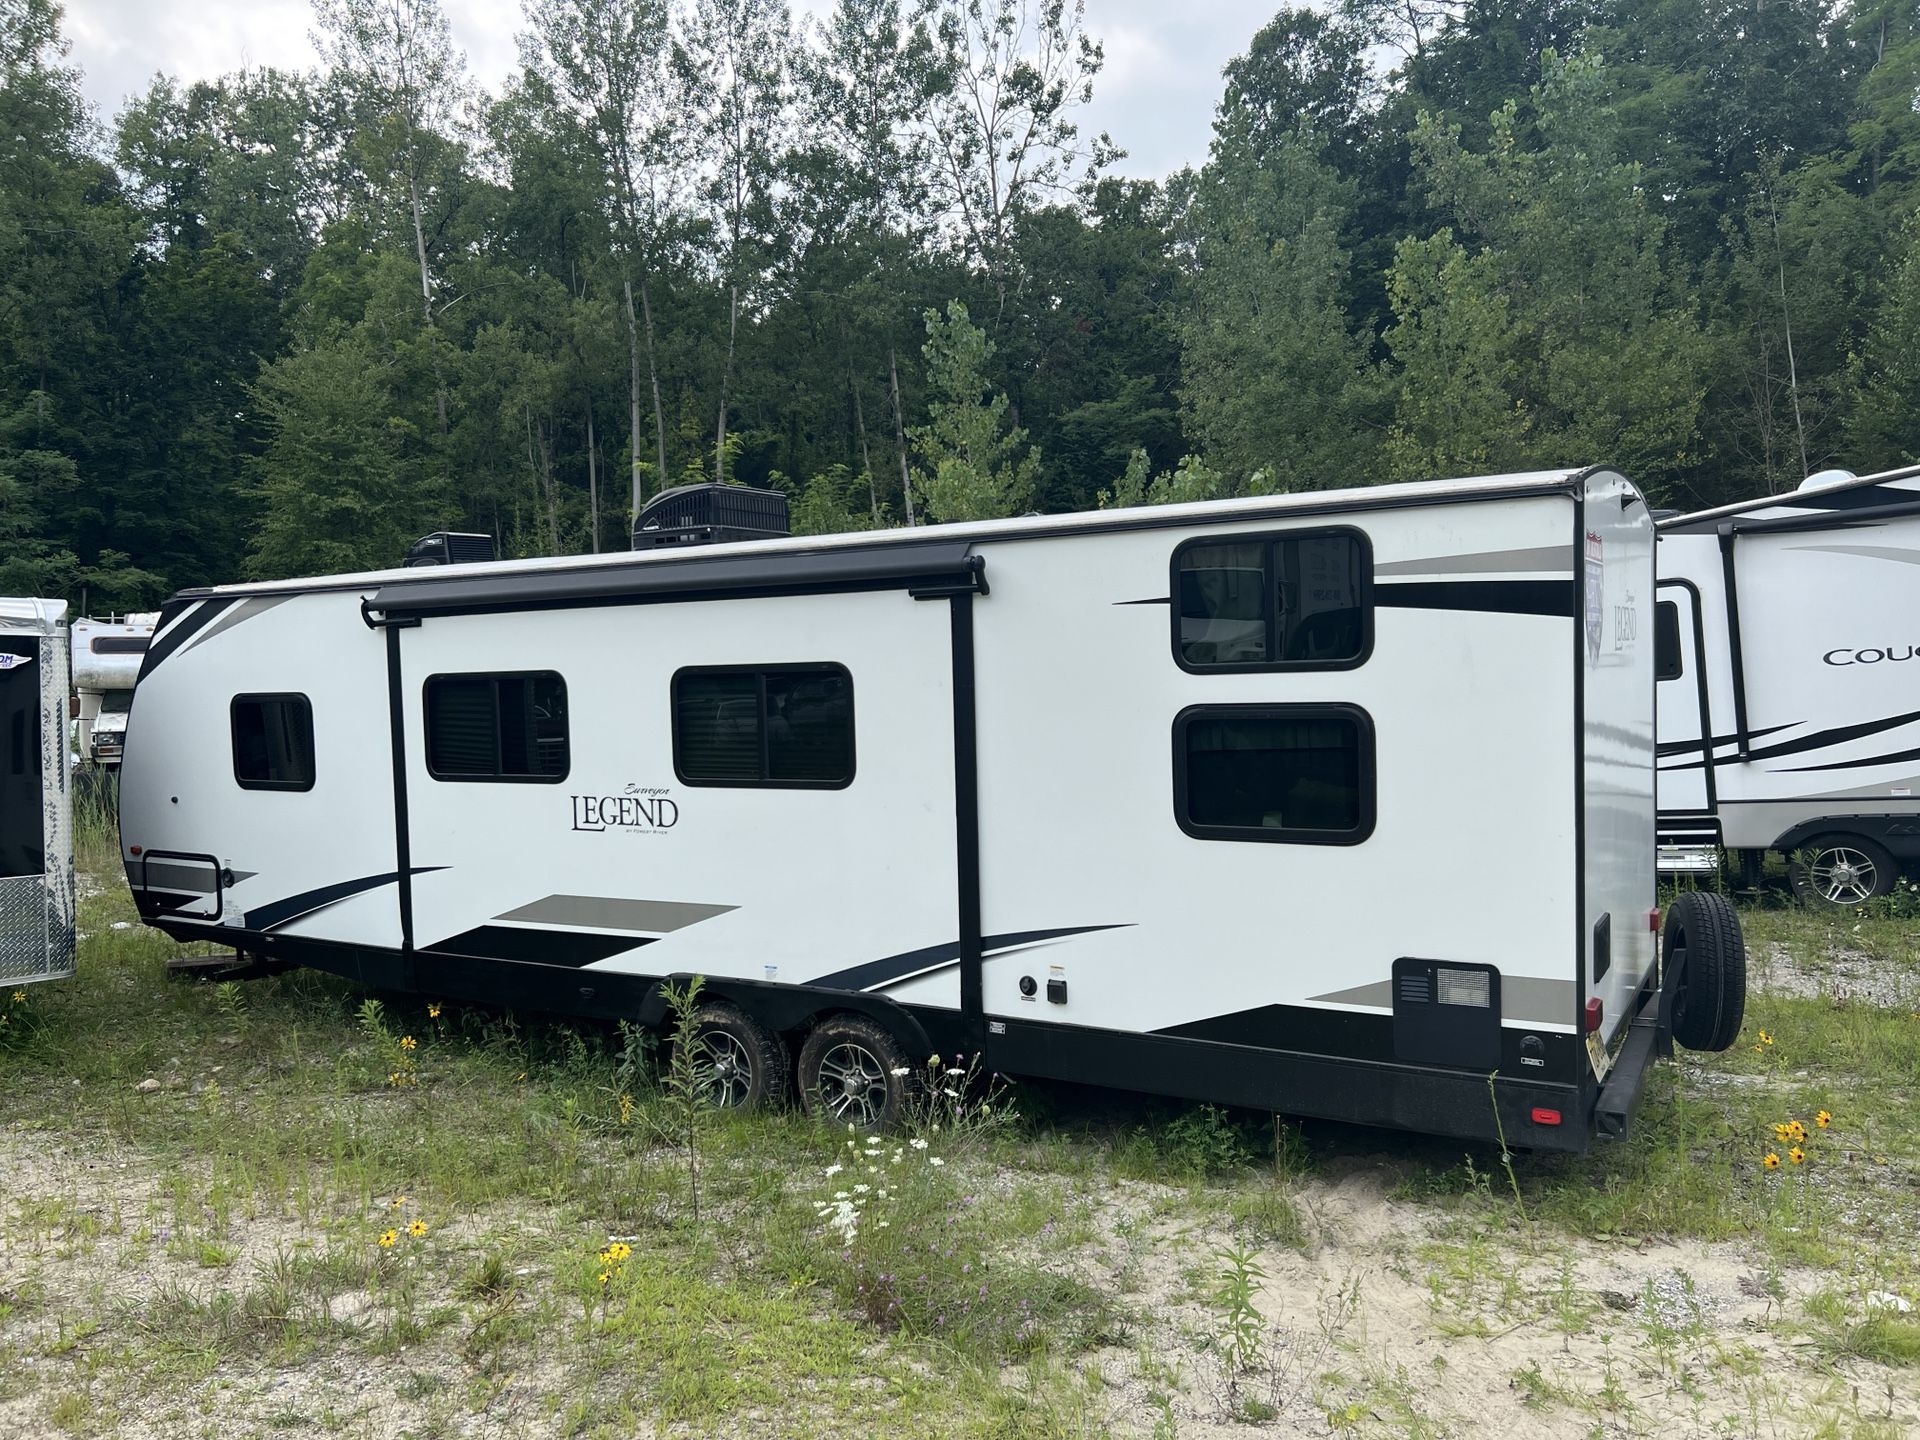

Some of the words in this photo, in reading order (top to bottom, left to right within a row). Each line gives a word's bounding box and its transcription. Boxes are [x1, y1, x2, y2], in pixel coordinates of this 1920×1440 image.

[1614, 605, 1637, 651] LEGEND
[1823, 645, 1920, 666] COU
[624, 783, 670, 797] Surveyor
[570, 795, 679, 832] LEGEND
